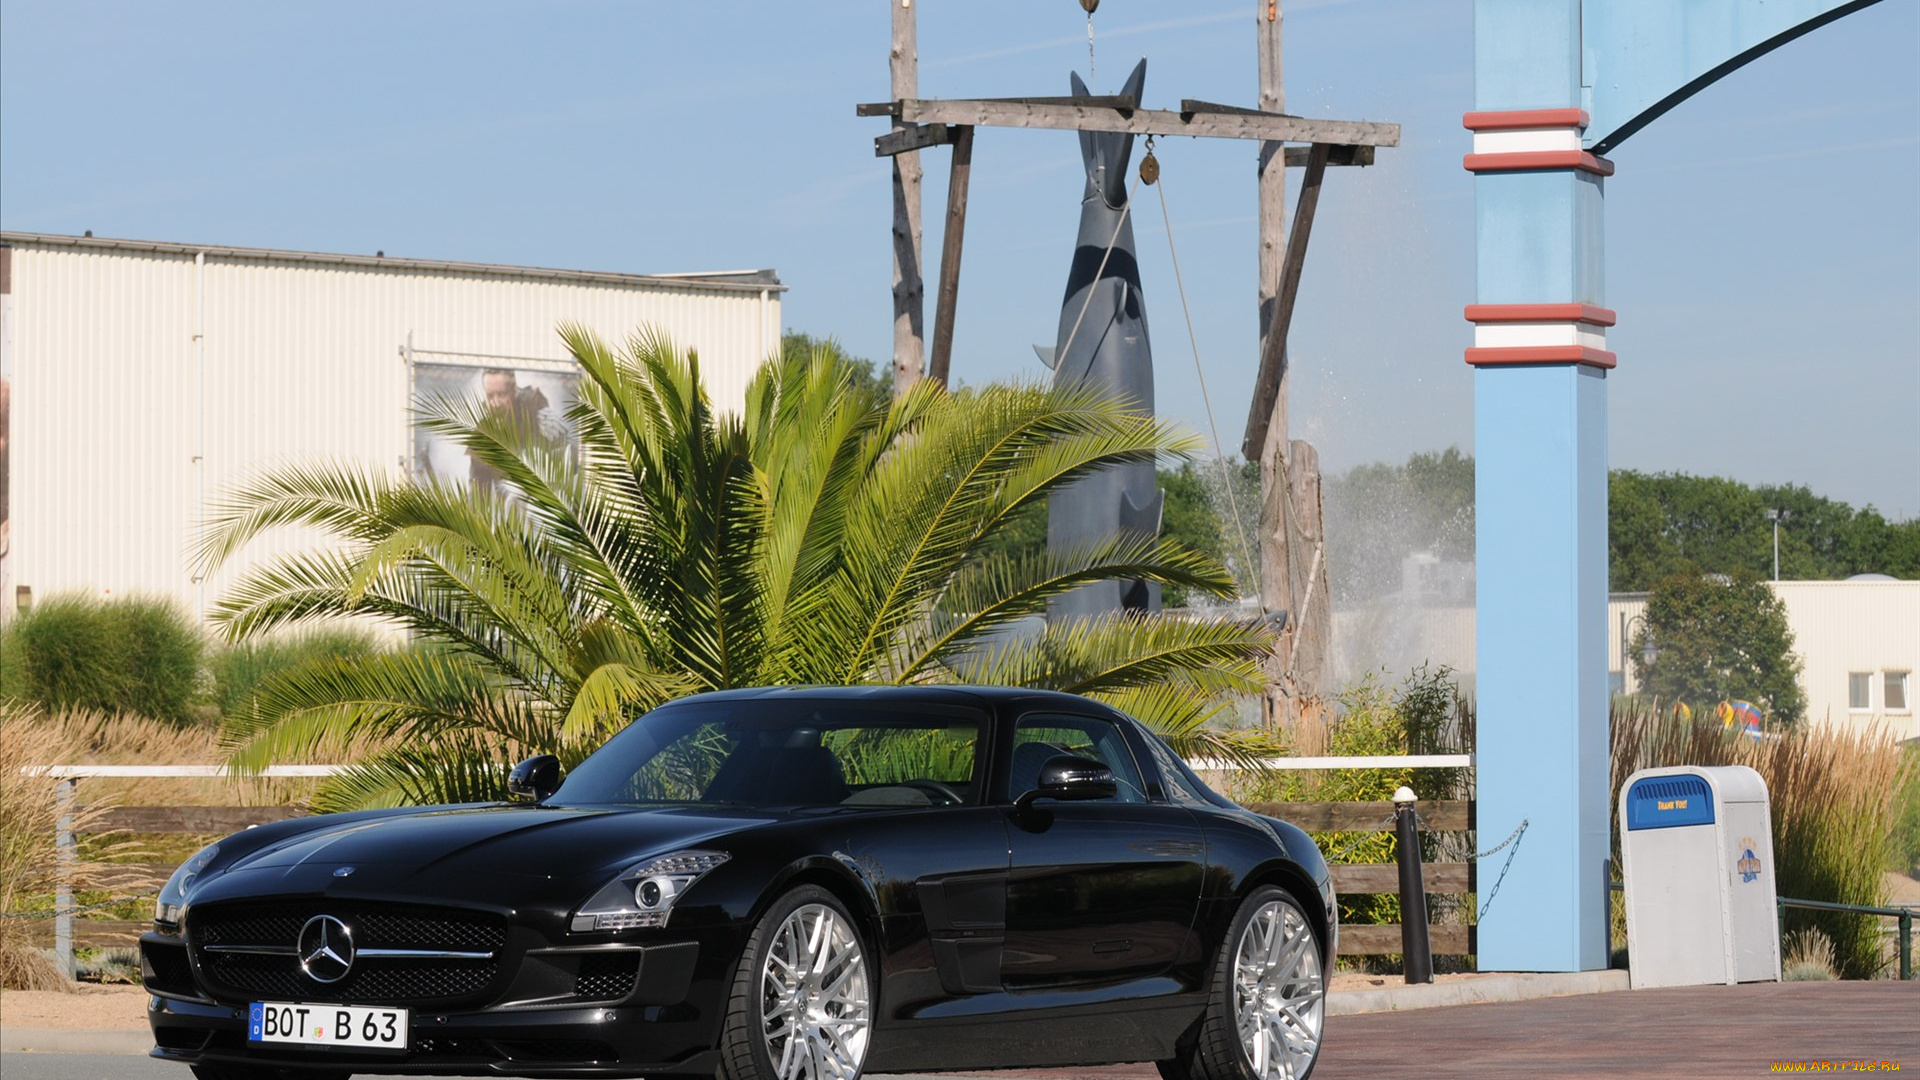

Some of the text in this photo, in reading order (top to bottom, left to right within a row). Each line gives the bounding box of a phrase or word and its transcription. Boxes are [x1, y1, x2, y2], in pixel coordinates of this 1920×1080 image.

[253, 1025, 260, 1035] D
[264, 1007, 397, 1042] BOT B 63
